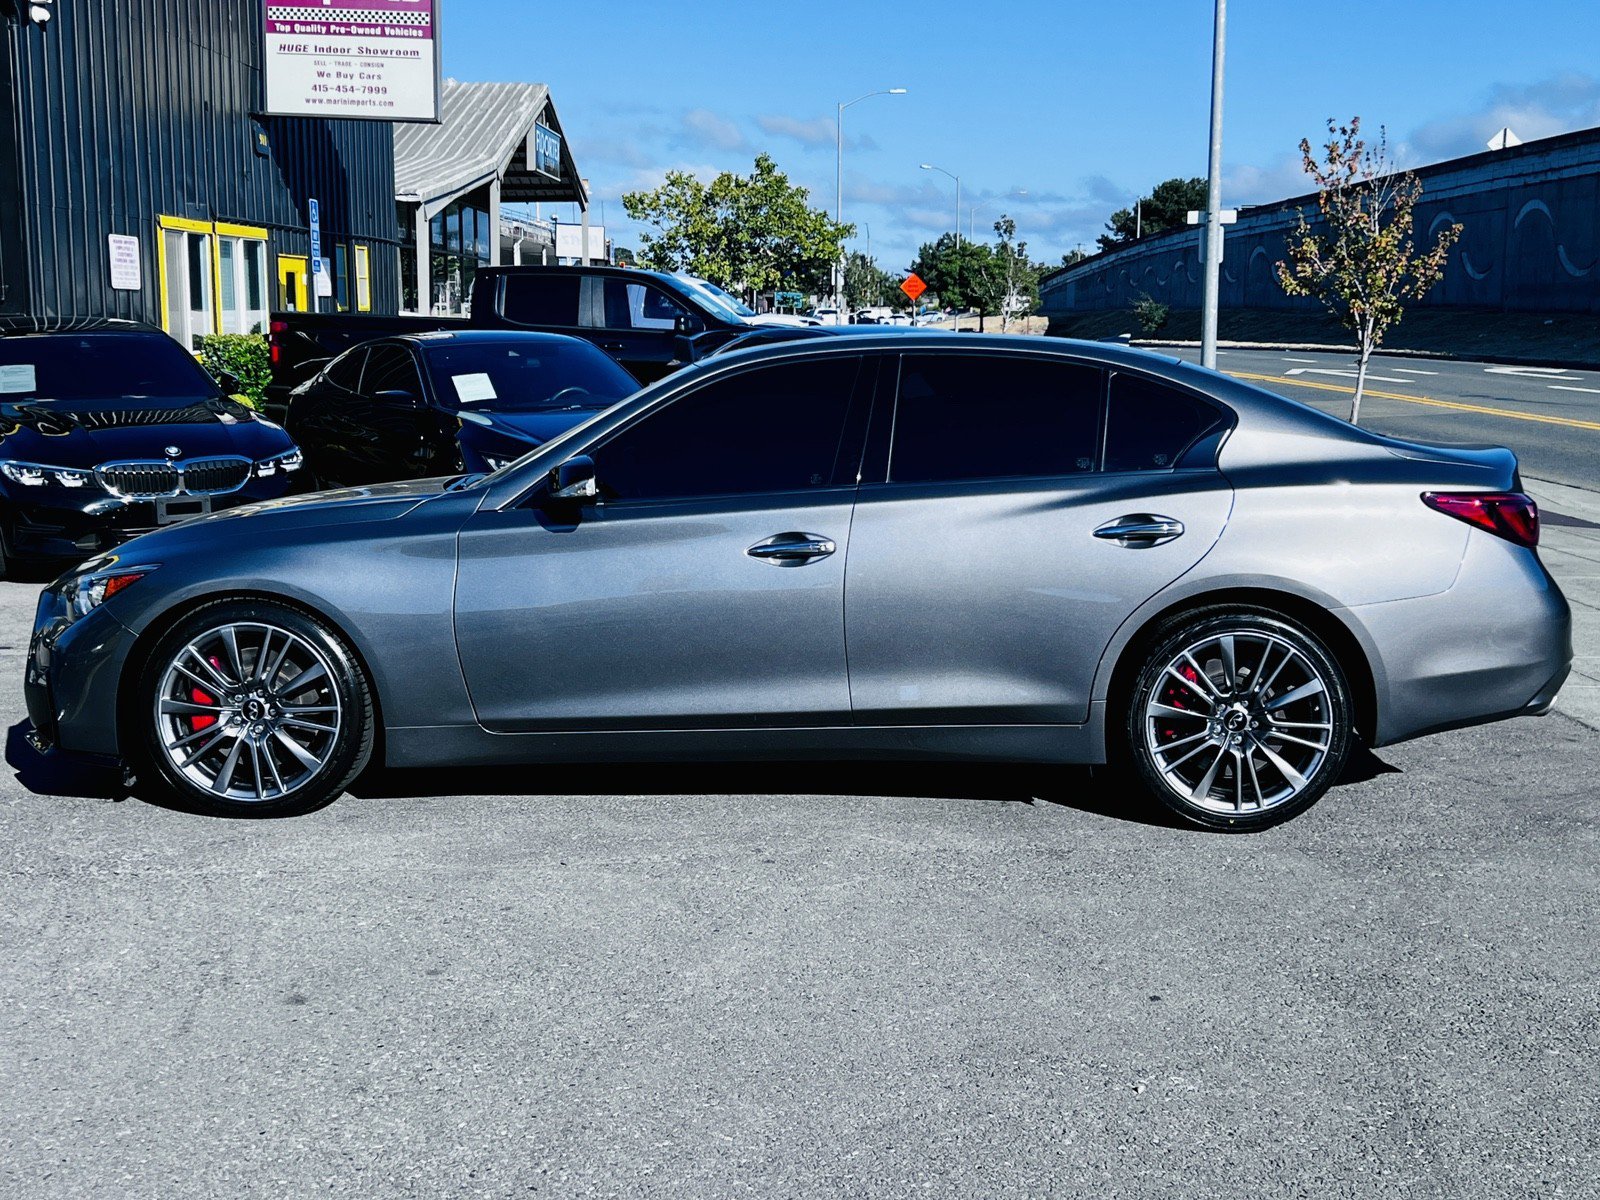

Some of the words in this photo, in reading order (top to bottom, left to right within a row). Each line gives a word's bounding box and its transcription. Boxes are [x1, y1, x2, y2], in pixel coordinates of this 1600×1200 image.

[274, 22, 290, 33] Top
[294, 24, 326, 34] Quality
[330, 24, 381, 35] Pre-Owned
[384, 26, 423, 37] Vehicles
[279, 44, 309, 52] HUGE
[314, 45, 351, 54] Indoor
[357, 46, 420, 56] Showroom
[336, 72, 354, 80] Buy
[312, 84, 387, 94] 415-454-7999
[305, 98, 394, 107] www.marinimports.com
